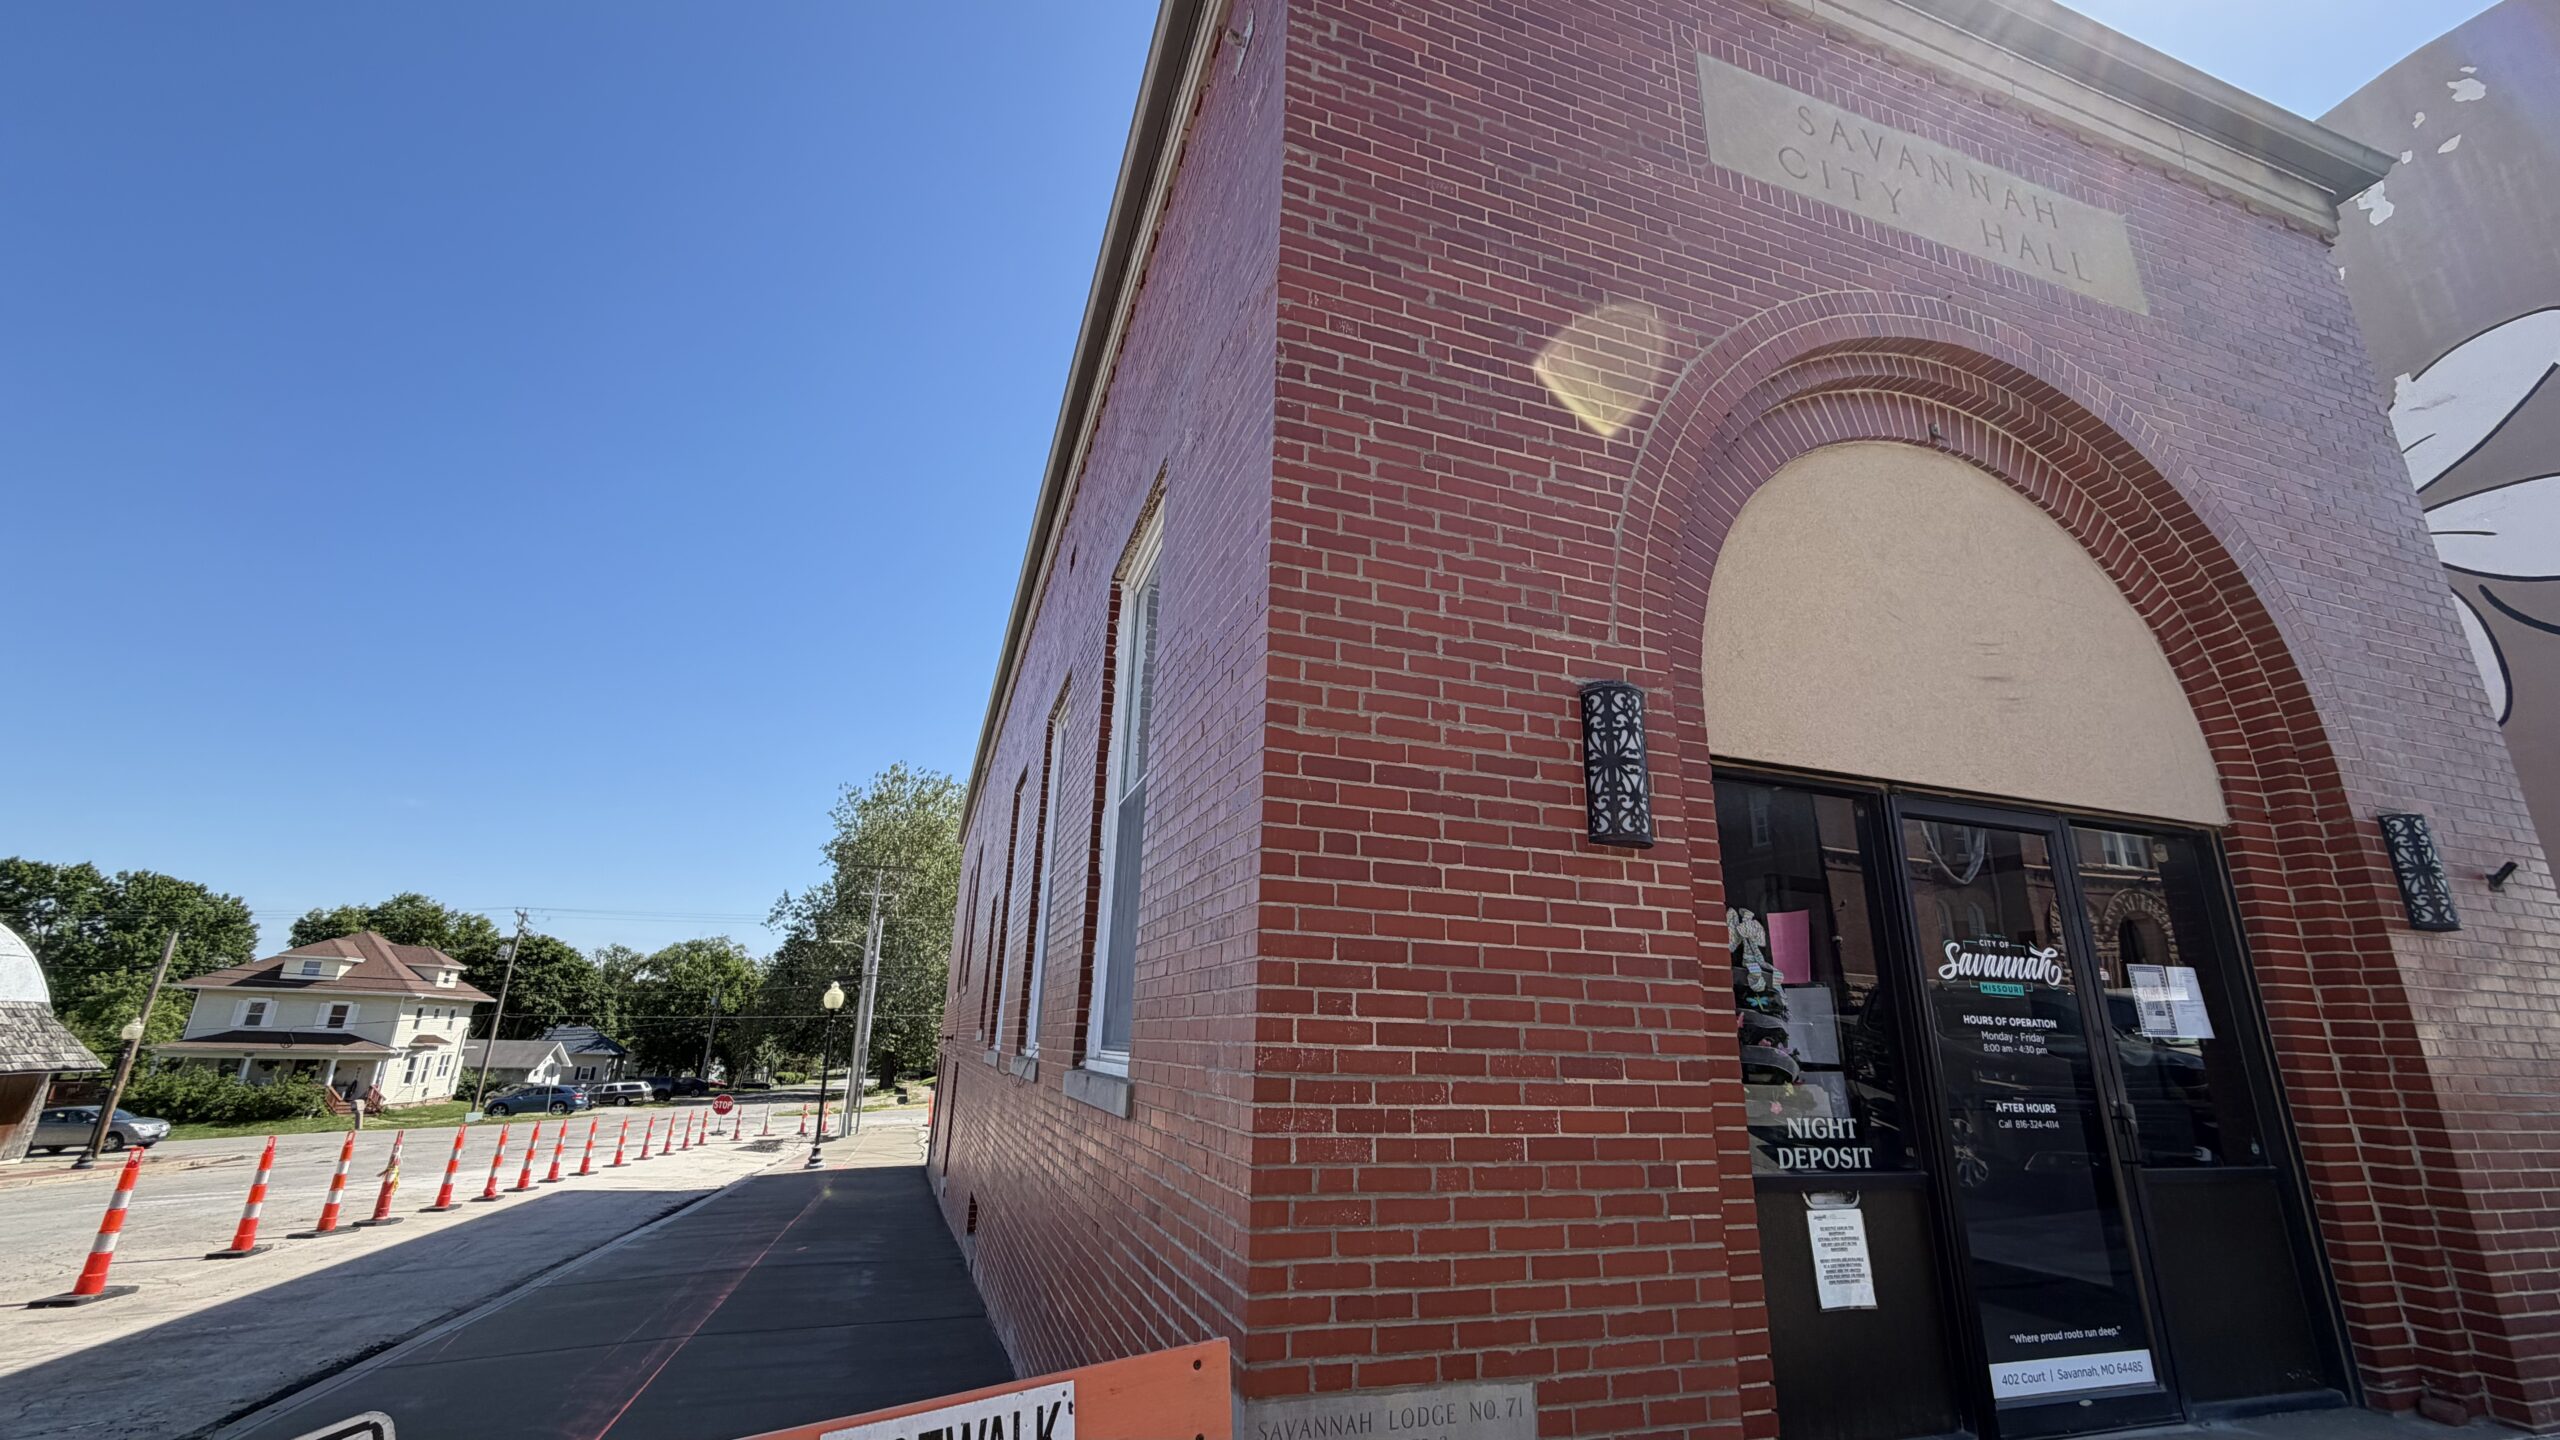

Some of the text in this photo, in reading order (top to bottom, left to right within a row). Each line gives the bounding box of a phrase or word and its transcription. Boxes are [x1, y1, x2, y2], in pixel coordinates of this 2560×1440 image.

[1797, 105, 2060, 229] SAVANNAH
[1778, 146, 2092, 283] CITY HALL
[1979, 939, 2009, 949] CITY OF
[1938, 942, 2062, 986] Savannah
[1982, 983, 2022, 994] MISSOURI
[1963, 1015, 2057, 1029] HOURS OF OPERATION
[1981, 1031, 2013, 1043] Monday
[2020, 1033, 2045, 1044] Friday
[1984, 1043, 2000, 1052] 8:00
[2019, 1045, 2034, 1054] 4:30
[2036, 1047, 2048, 1055] pm
[714, 1101, 733, 1109] STOP
[1996, 1103, 2056, 1114] AFTER HOURS
[1787, 1117, 1857, 1139] NIGHT
[1998, 1120, 2060, 1129] Call 816-324-4114
[1777, 1147, 1873, 1169] DEPOSIT
[2040, 1331, 2063, 1344] proud
[2064, 1329, 2083, 1340] roots
[2085, 1329, 2098, 1338] run
[2001, 1373, 2020, 1386] 402
[2021, 1371, 2046, 1385] Court
[2058, 1365, 2100, 1381] Savannah,
[2101, 1363, 2115, 1375] MO
[2117, 1361, 2143, 1374] 64485
[1257, 1412, 1373, 1440] SAVANNAH
[1389, 1403, 1457, 1430] LODGE
